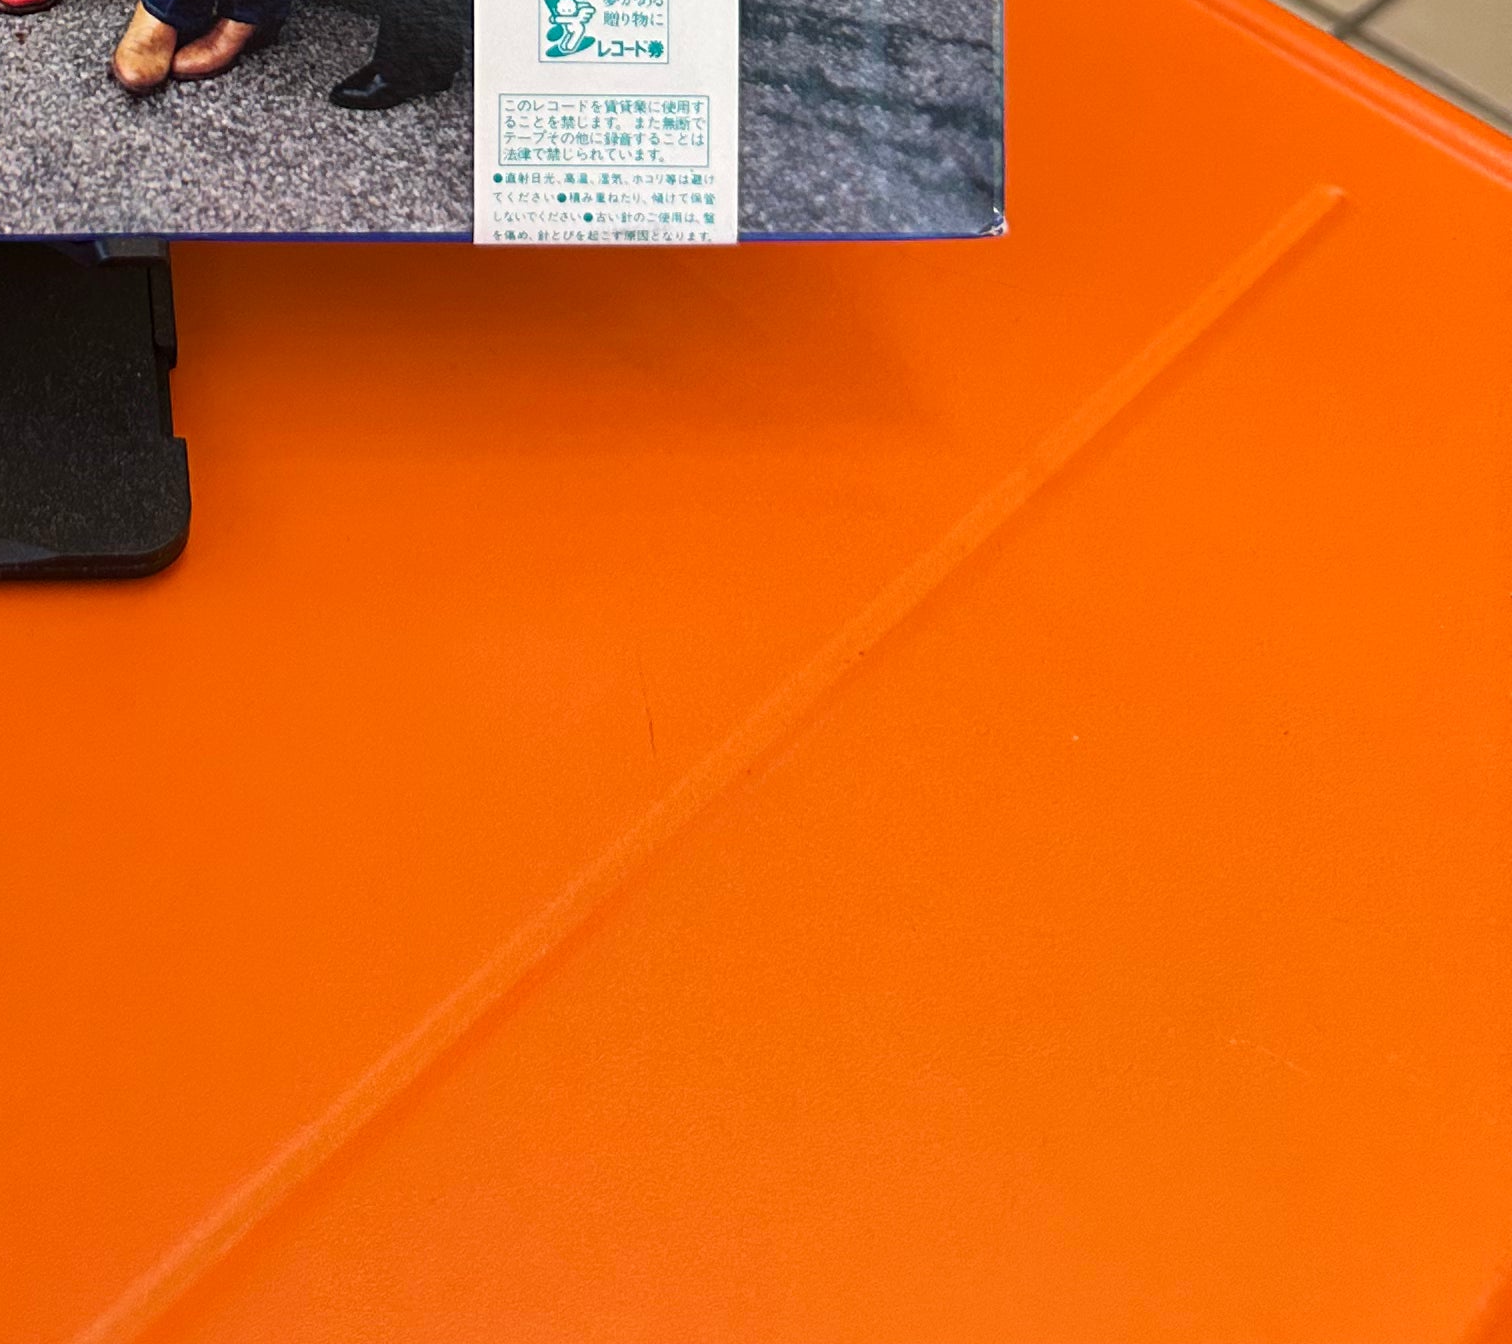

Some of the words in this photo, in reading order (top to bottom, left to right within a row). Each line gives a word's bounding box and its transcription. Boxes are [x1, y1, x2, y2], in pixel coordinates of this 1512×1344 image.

[603, 10, 664, 27] 贈り物に
[597, 39, 664, 58] レコード券
